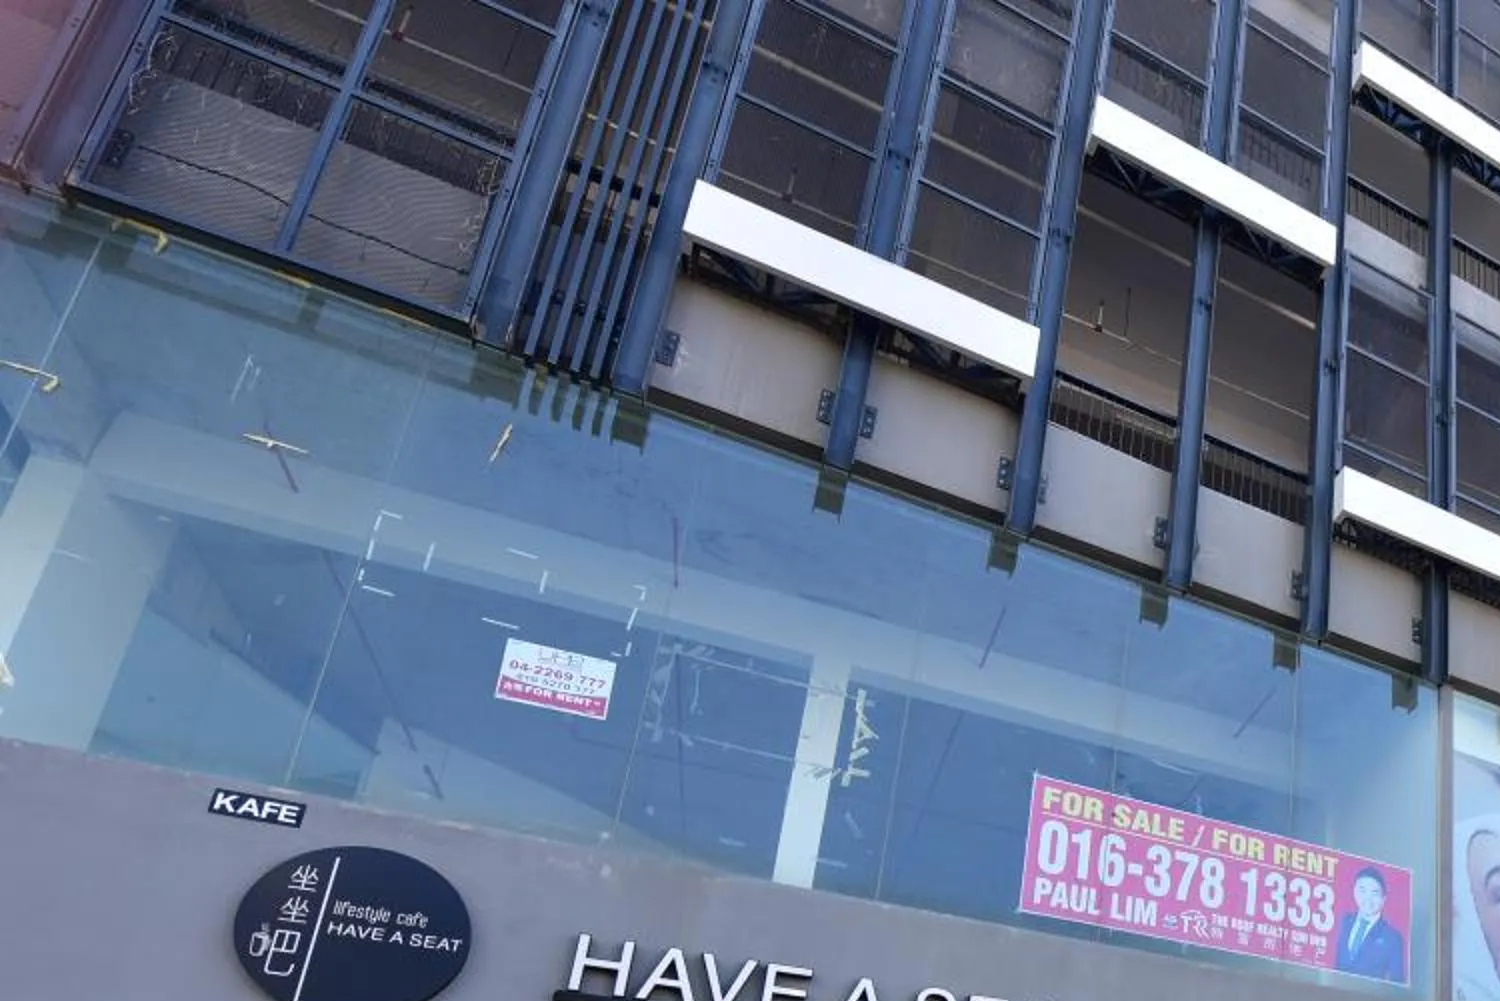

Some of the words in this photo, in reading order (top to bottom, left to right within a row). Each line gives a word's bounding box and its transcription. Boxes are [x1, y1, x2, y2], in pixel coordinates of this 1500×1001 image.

[212, 791, 300, 825] KAFE
[1042, 785, 1104, 822] FOR
[1112, 804, 1185, 842] SALE
[1211, 827, 1265, 861] FOR
[1273, 843, 1340, 878] RENT
[1036, 818, 1226, 910] 016-378
[1239, 866, 1336, 934] 1333
[333, 900, 391, 924] lifestyle
[396, 910, 429, 929] cafe
[1032, 876, 1101, 916] PAUL
[1109, 892, 1159, 928] LIM
[326, 921, 385, 943] HAVE
[388, 931, 404, 945] A
[408, 931, 463, 953] SEAT
